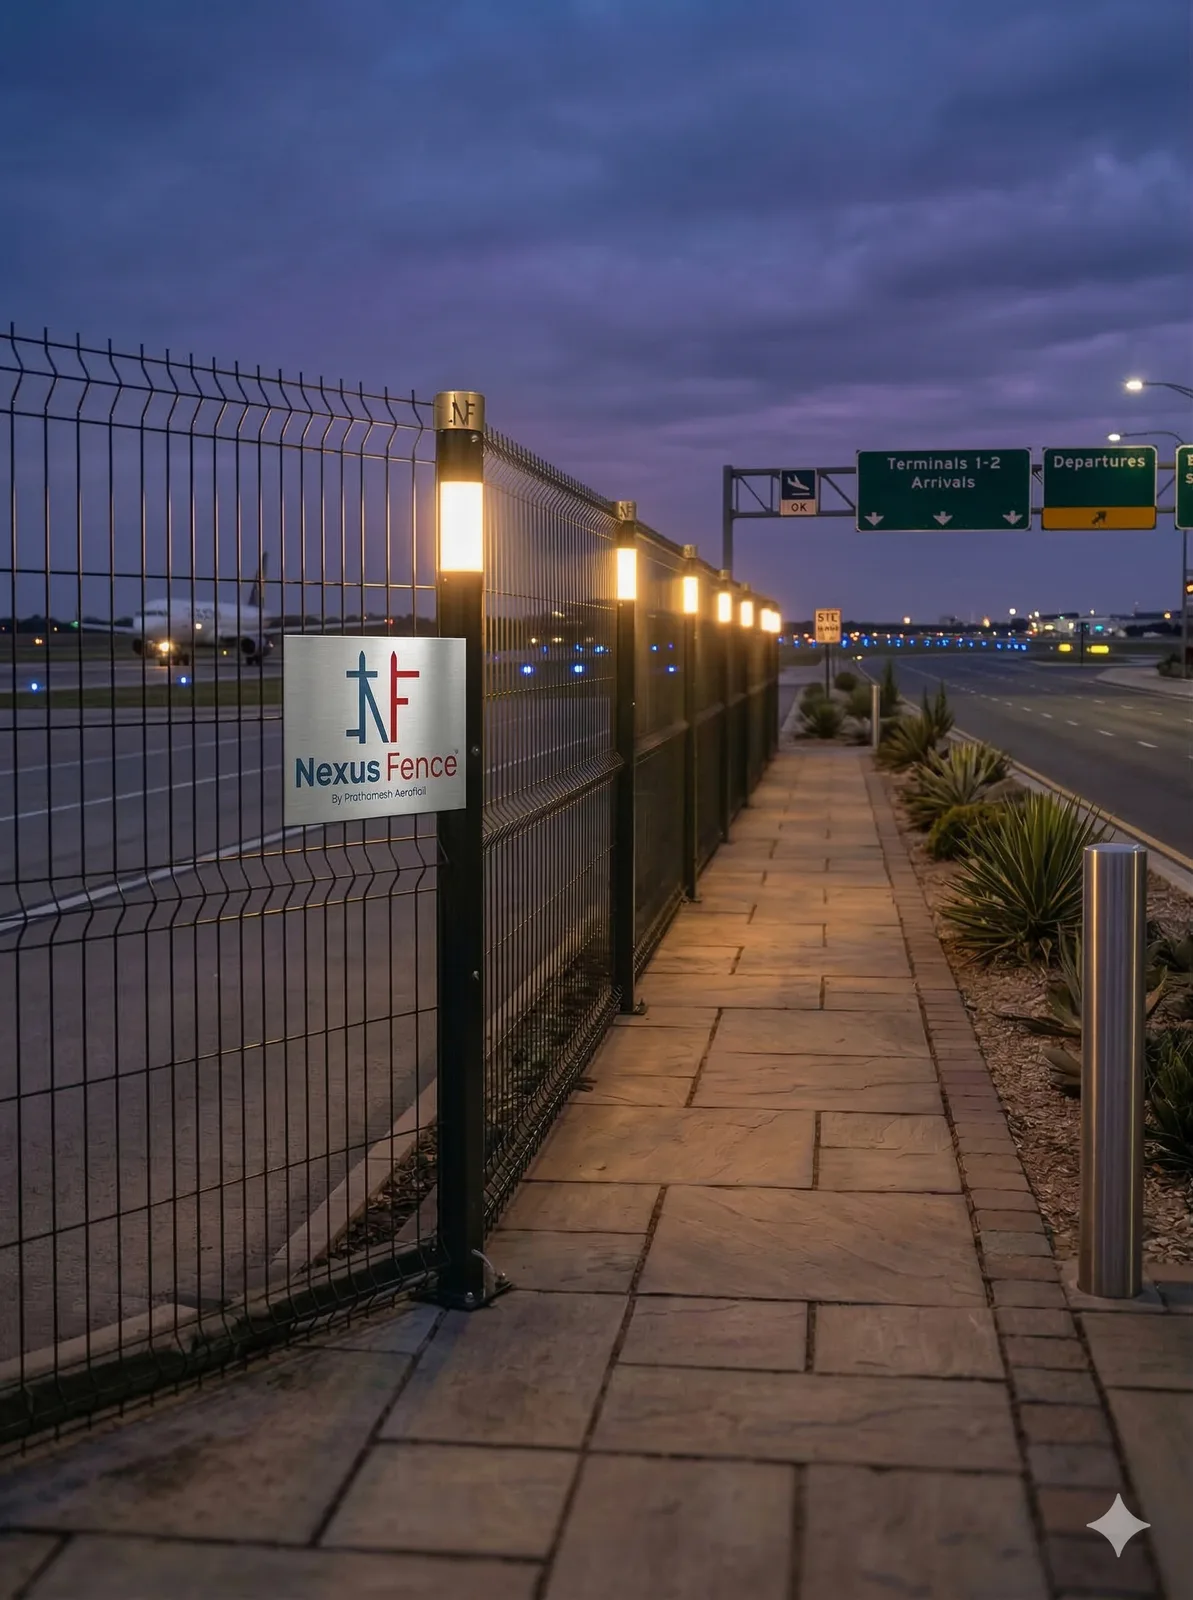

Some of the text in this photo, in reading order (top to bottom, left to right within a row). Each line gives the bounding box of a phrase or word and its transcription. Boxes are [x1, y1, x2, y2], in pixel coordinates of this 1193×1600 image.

[887, 456, 1001, 470] Terminals 1-2
[1053, 455, 1145, 471] Departures
[911, 476, 976, 489] Arrivals
[791, 503, 807, 512] OK
[295, 752, 457, 788] Nexus Fence
[332, 794, 343, 805] By
[344, 790, 393, 803] Prathamesh
